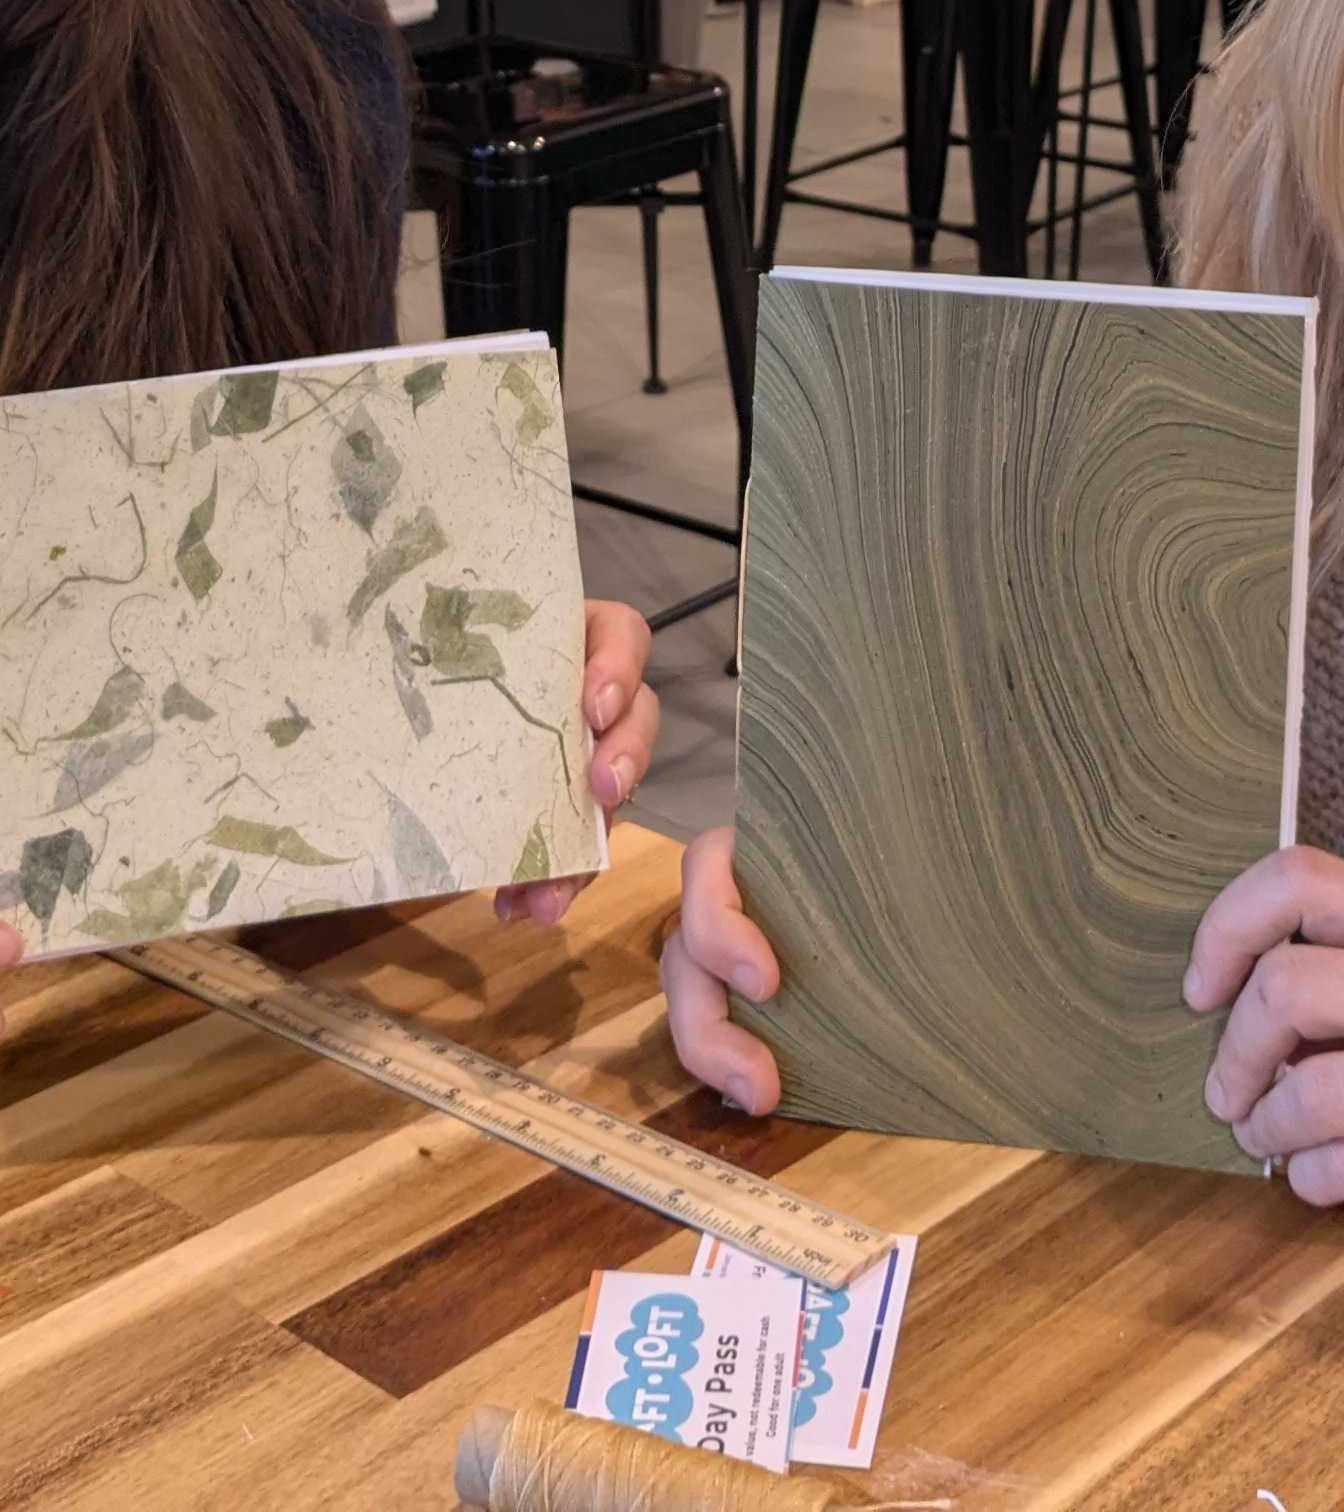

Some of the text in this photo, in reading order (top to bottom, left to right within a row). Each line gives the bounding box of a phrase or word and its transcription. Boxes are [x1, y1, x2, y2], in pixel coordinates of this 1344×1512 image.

[538, 1091, 561, 1104] 20
[655, 1145, 674, 1157] 24
[686, 1158, 706, 1171] 25
[716, 1173, 738, 1185] 26
[747, 1186, 770, 1198] 27
[778, 1199, 802, 1213] 28
[812, 1214, 834, 1228] 29
[843, 1228, 870, 1242] 30
[633, 1304, 685, 1368] LOFT
[757, 1338, 767, 1352] for
[760, 1315, 770, 1337] cash
[697, 1334, 740, 1454] Day Pass
[751, 1353, 765, 1408] redeemable
[765, 1352, 785, 1438] Good for one adult
[750, 1409, 758, 1426] not
